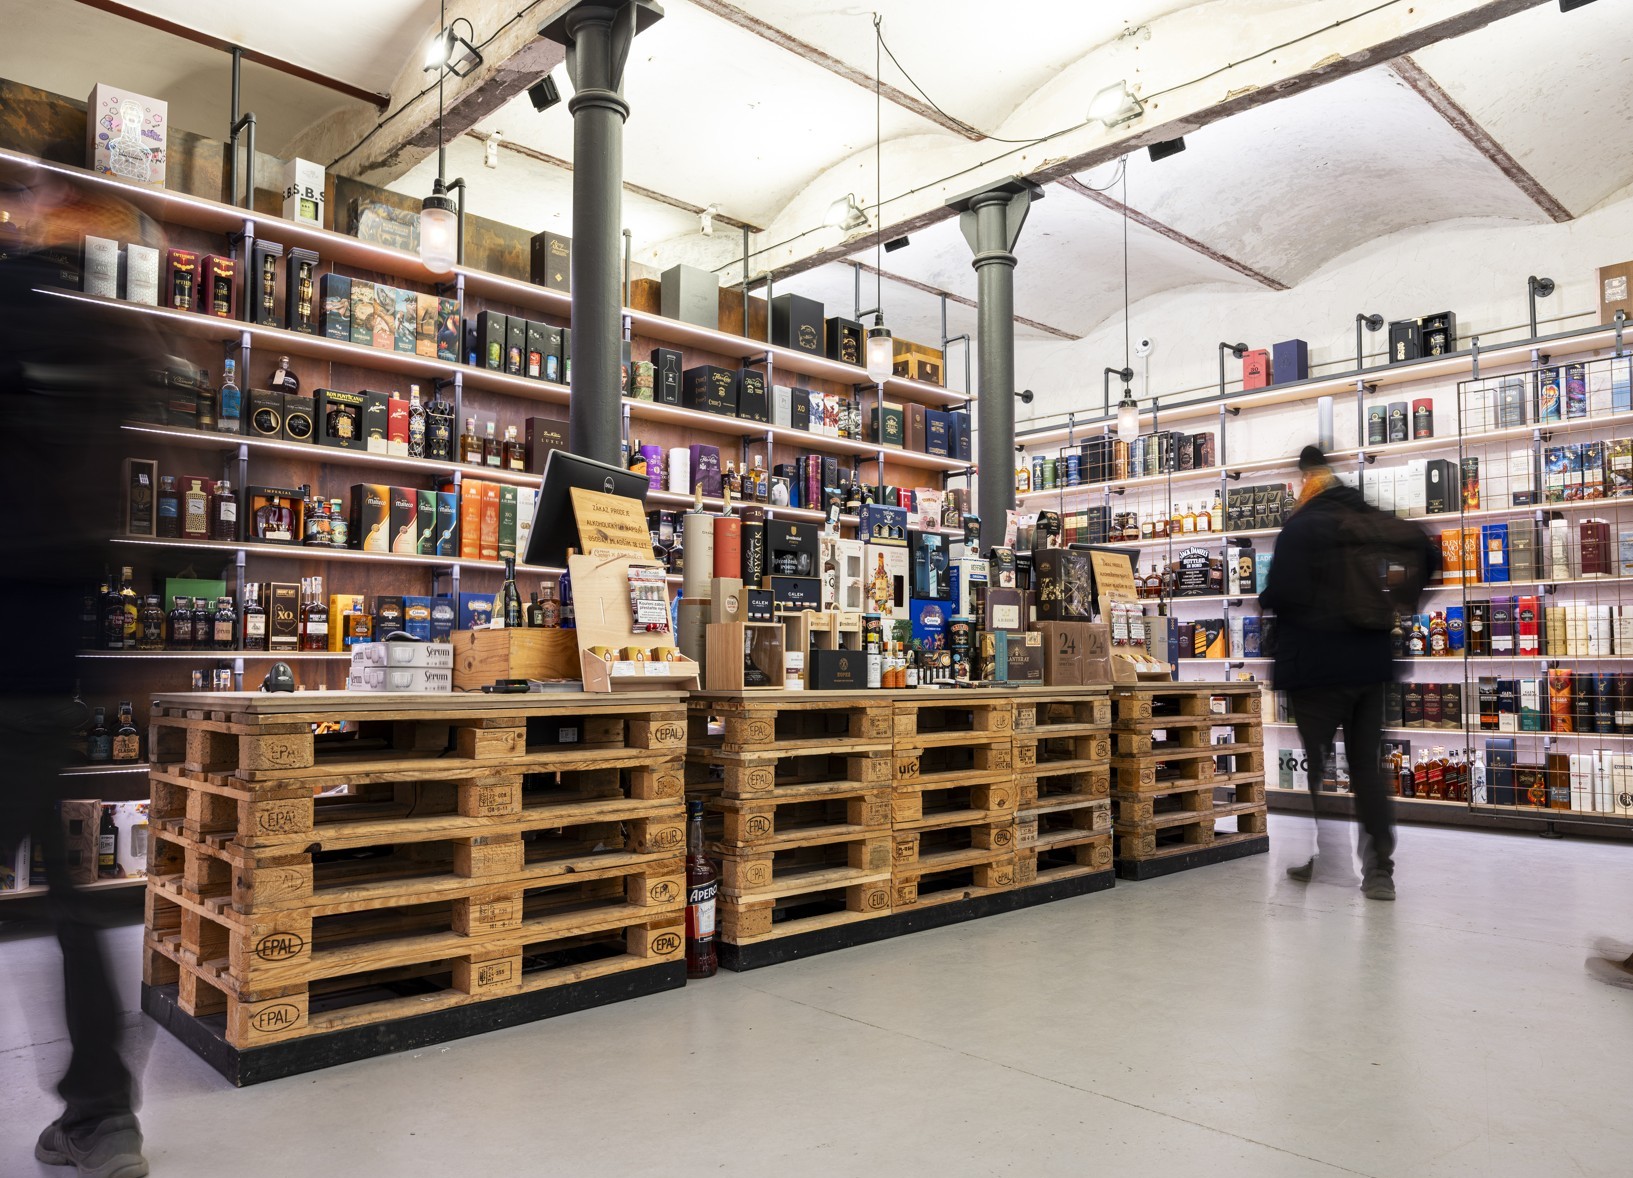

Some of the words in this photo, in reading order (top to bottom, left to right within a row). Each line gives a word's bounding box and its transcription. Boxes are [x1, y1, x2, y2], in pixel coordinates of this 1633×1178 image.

[264, 488, 292, 496] IMPERIAL
[605, 482, 614, 490] DELL
[1179, 549, 1191, 559] JACK
[277, 611, 294, 620] XO
[1059, 632, 1076, 655] 24
[1088, 633, 1104, 655] 24
[660, 728, 680, 740] EPAL
[751, 773, 769, 785] EPAL
[660, 830, 677, 845] EUR
[996, 833, 1009, 843] EPAL
[872, 893, 885, 907] EUR
[263, 938, 297, 956] EPAL
[656, 936, 677, 951] EPAL
